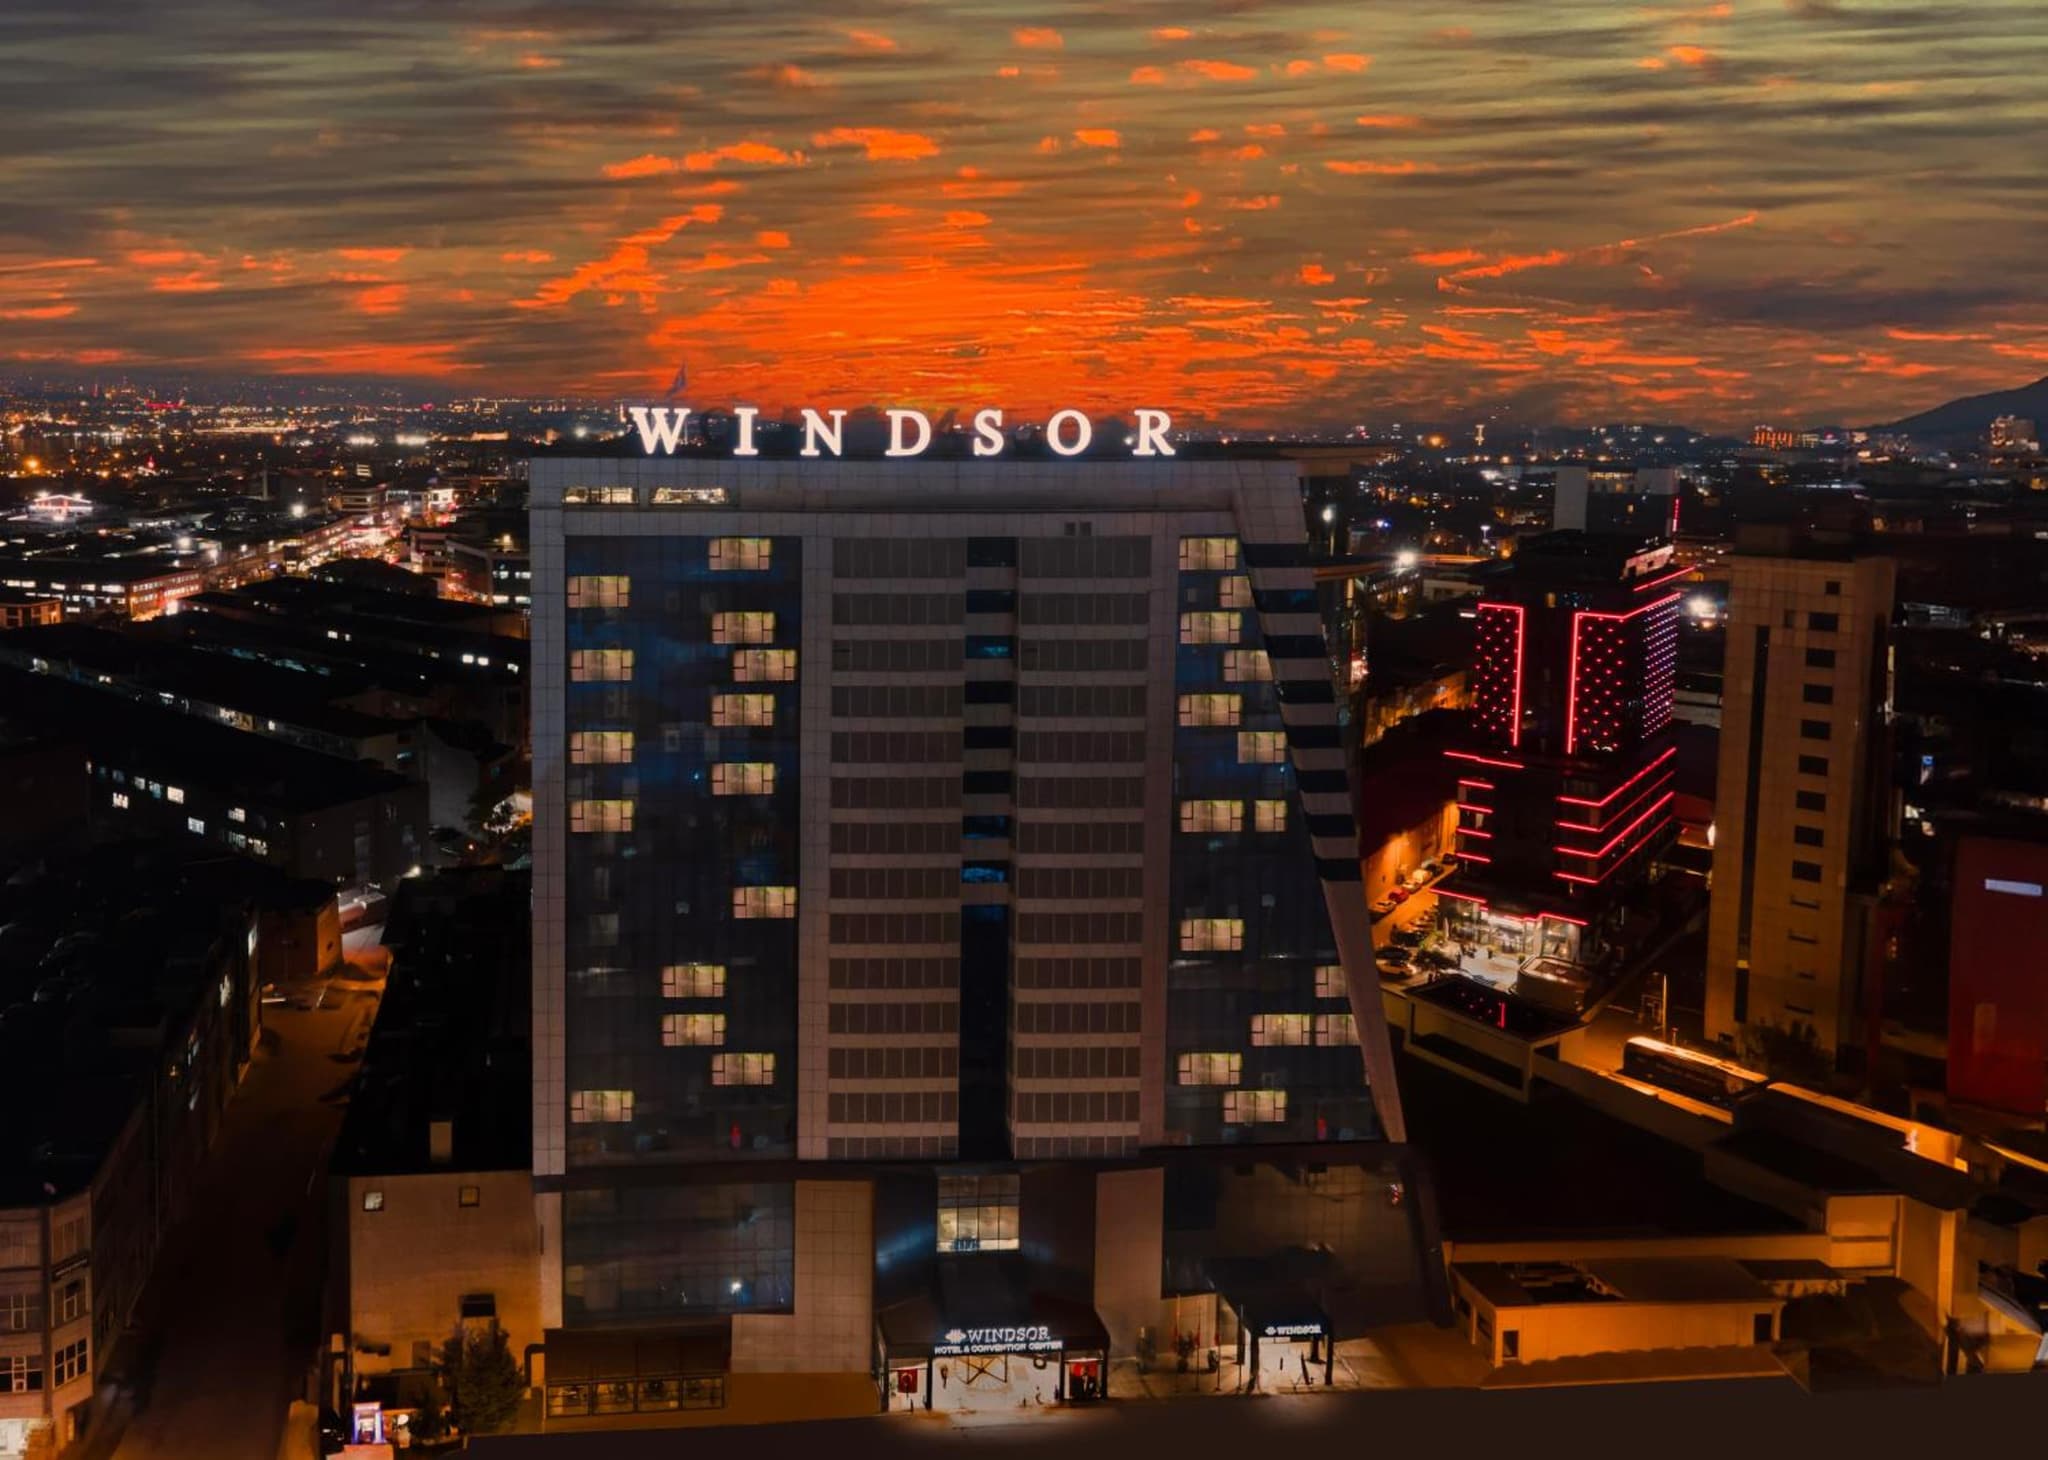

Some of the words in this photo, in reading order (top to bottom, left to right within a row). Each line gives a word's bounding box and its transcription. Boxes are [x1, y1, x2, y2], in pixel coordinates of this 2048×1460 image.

[629, 407, 1176, 456] WINDSOR
[967, 1326, 1049, 1343] WINDSOR
[934, 1346, 962, 1355] HOTEL
[971, 1343, 1026, 1353] CONVENTION
[1028, 1340, 1063, 1351] CENTER
